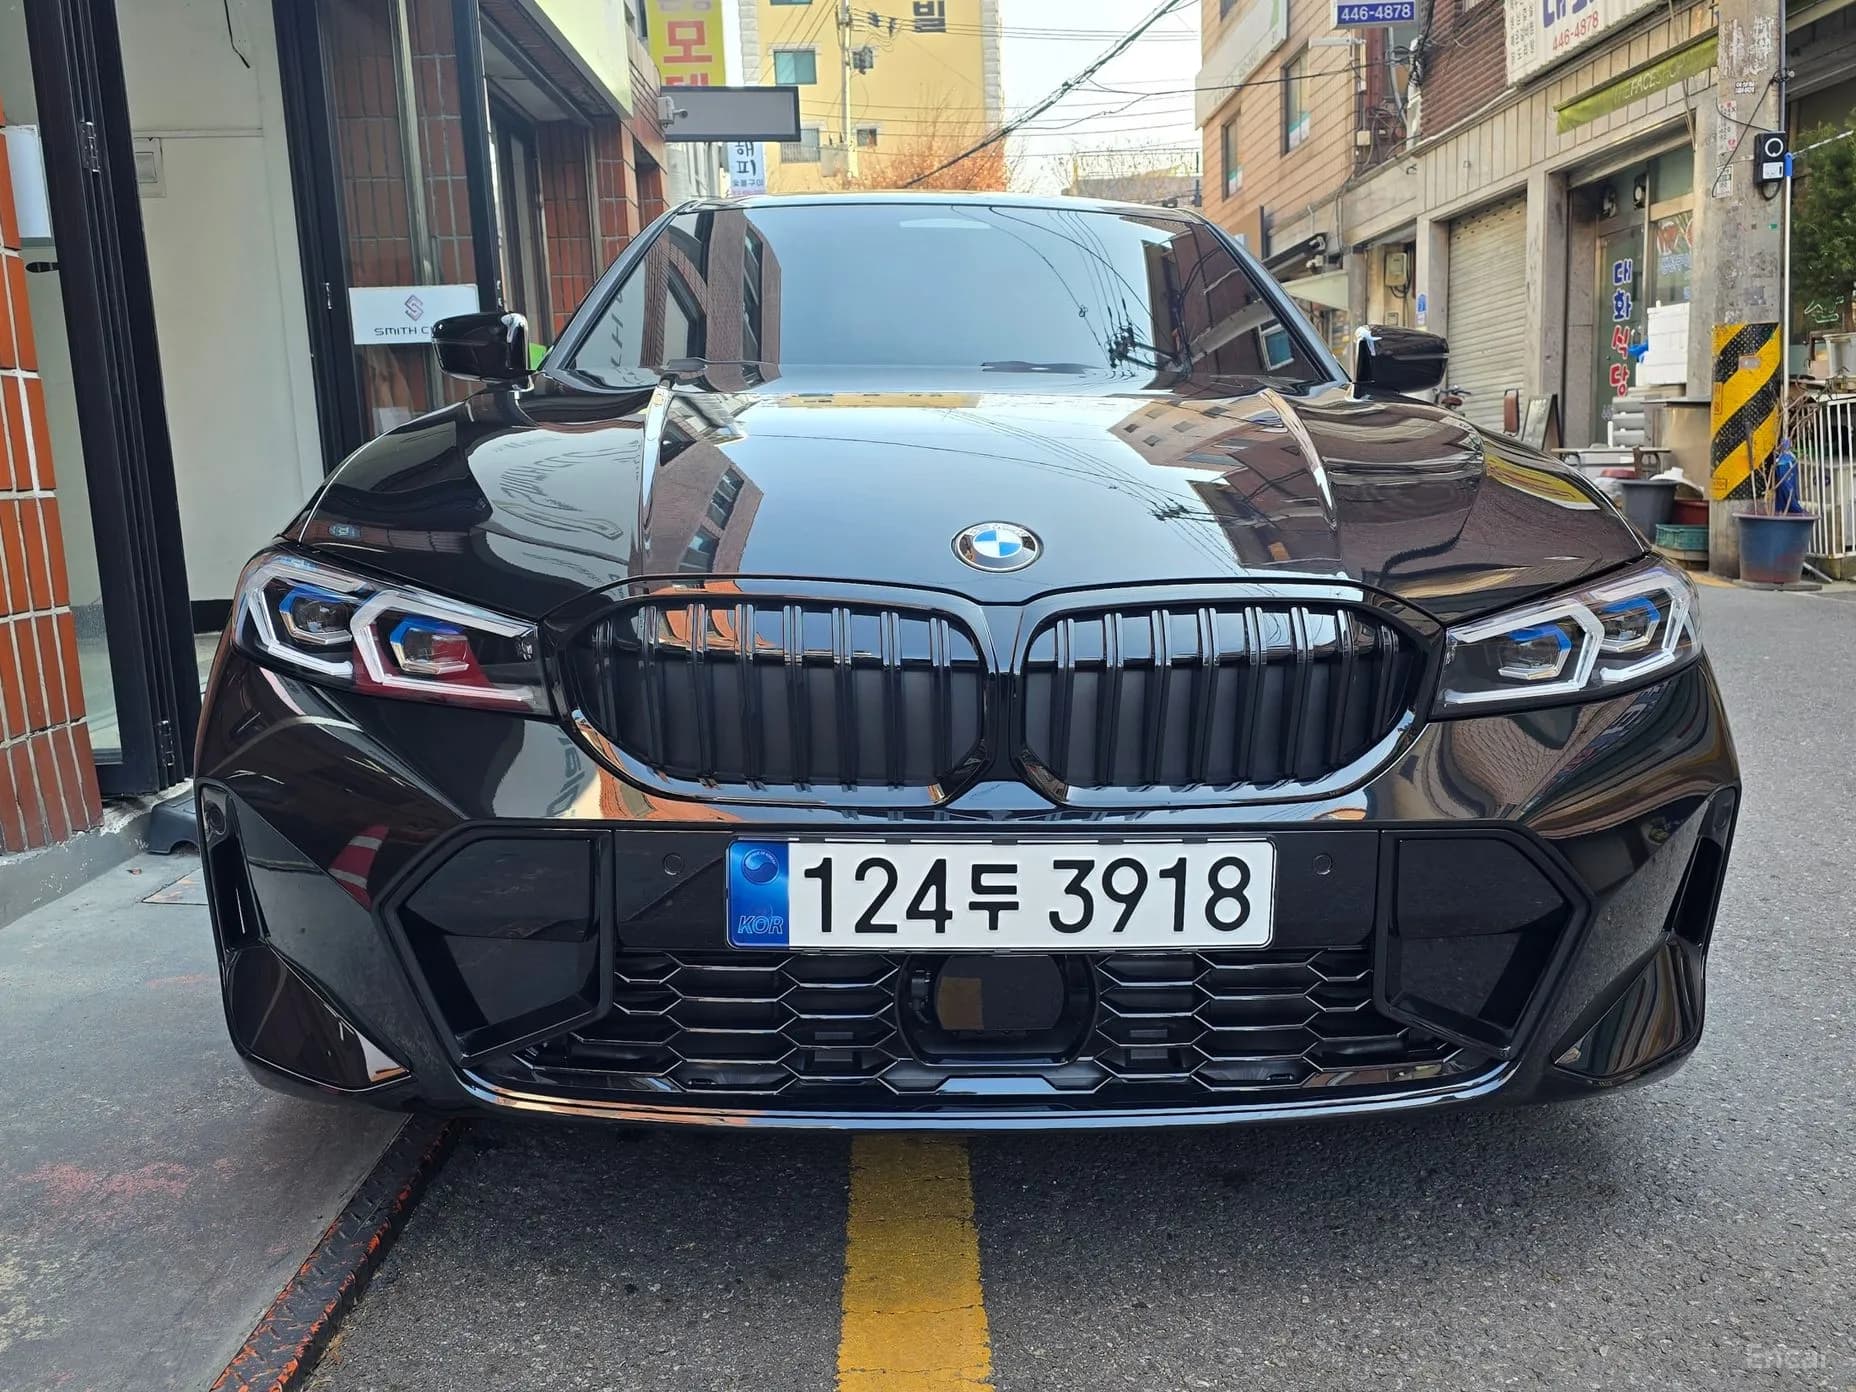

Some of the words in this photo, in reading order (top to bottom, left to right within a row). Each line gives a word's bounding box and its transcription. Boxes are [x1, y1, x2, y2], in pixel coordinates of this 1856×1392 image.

[1340, 4, 1412, 21] 446-4878
[1552, 10, 1600, 51] 446-4878
[374, 326, 417, 336] SMITH
[420, 325, 433, 336] C
[1609, 258, 1633, 398] 대화식당
[803, 857, 1020, 934] 124두
[1048, 856, 1252, 934] 3918
[737, 915, 784, 935] KOR
